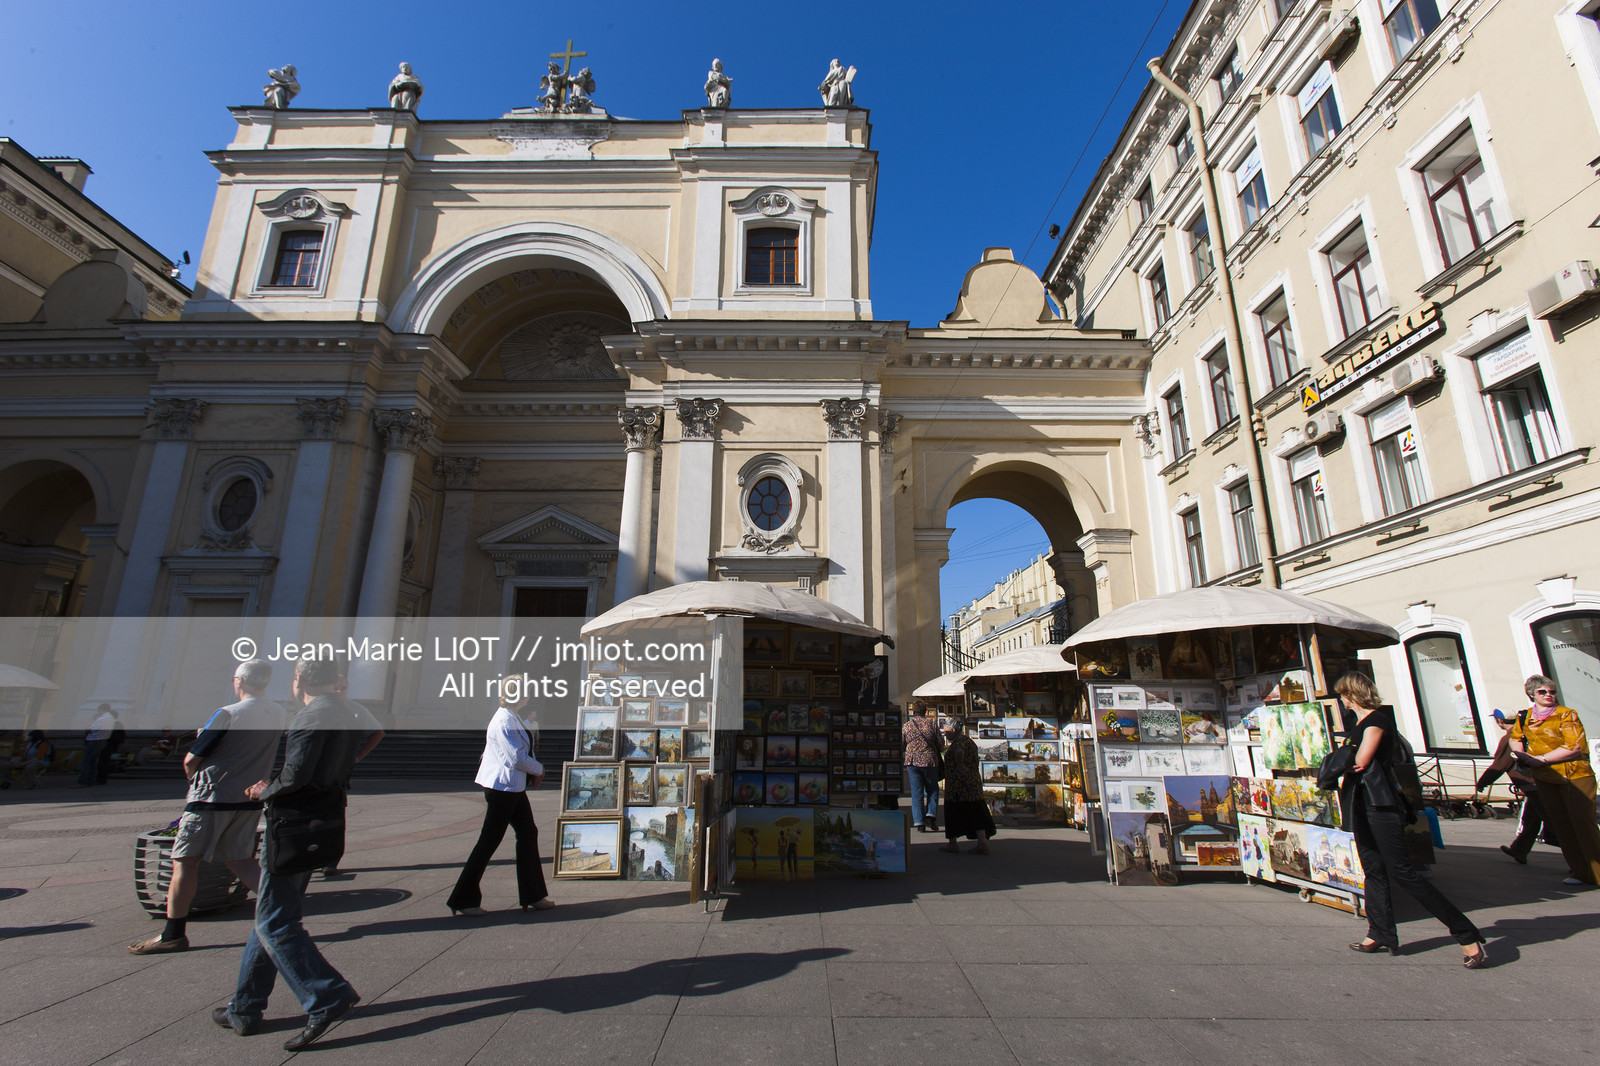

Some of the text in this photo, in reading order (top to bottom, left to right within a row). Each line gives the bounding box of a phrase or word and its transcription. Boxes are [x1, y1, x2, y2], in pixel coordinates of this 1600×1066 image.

[1323, 326, 1435, 398] НЕДВИЖИМОСТЬ
[1493, 343, 1527, 362] ГАРДАРИКА
[1495, 351, 1528, 370] GARDARIKA
